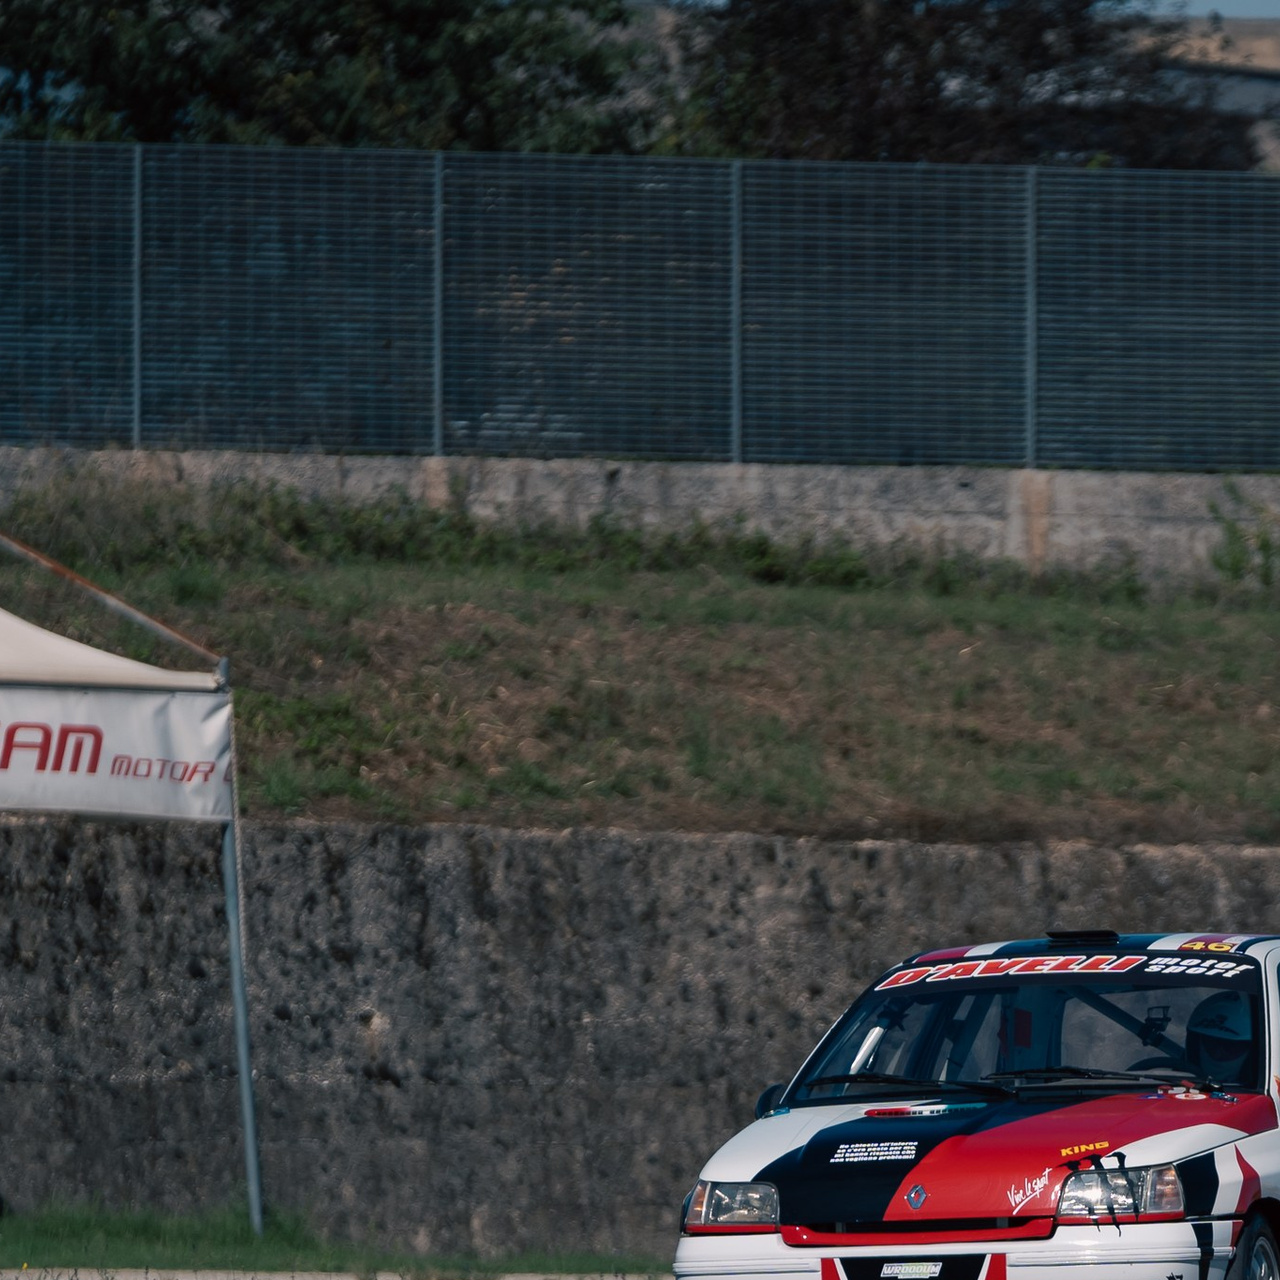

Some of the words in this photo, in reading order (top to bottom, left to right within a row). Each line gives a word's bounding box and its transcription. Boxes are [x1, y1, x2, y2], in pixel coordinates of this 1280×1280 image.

[0, 721, 104, 773] AM
[110, 753, 216, 783] MOTOR
[1181, 941, 1232, 951] 46
[1144, 965, 1240, 978] sport
[1148, 957, 1255, 972] motor
[874, 956, 1148, 991] D'AVELLI
[1060, 1141, 1109, 1157] KING
